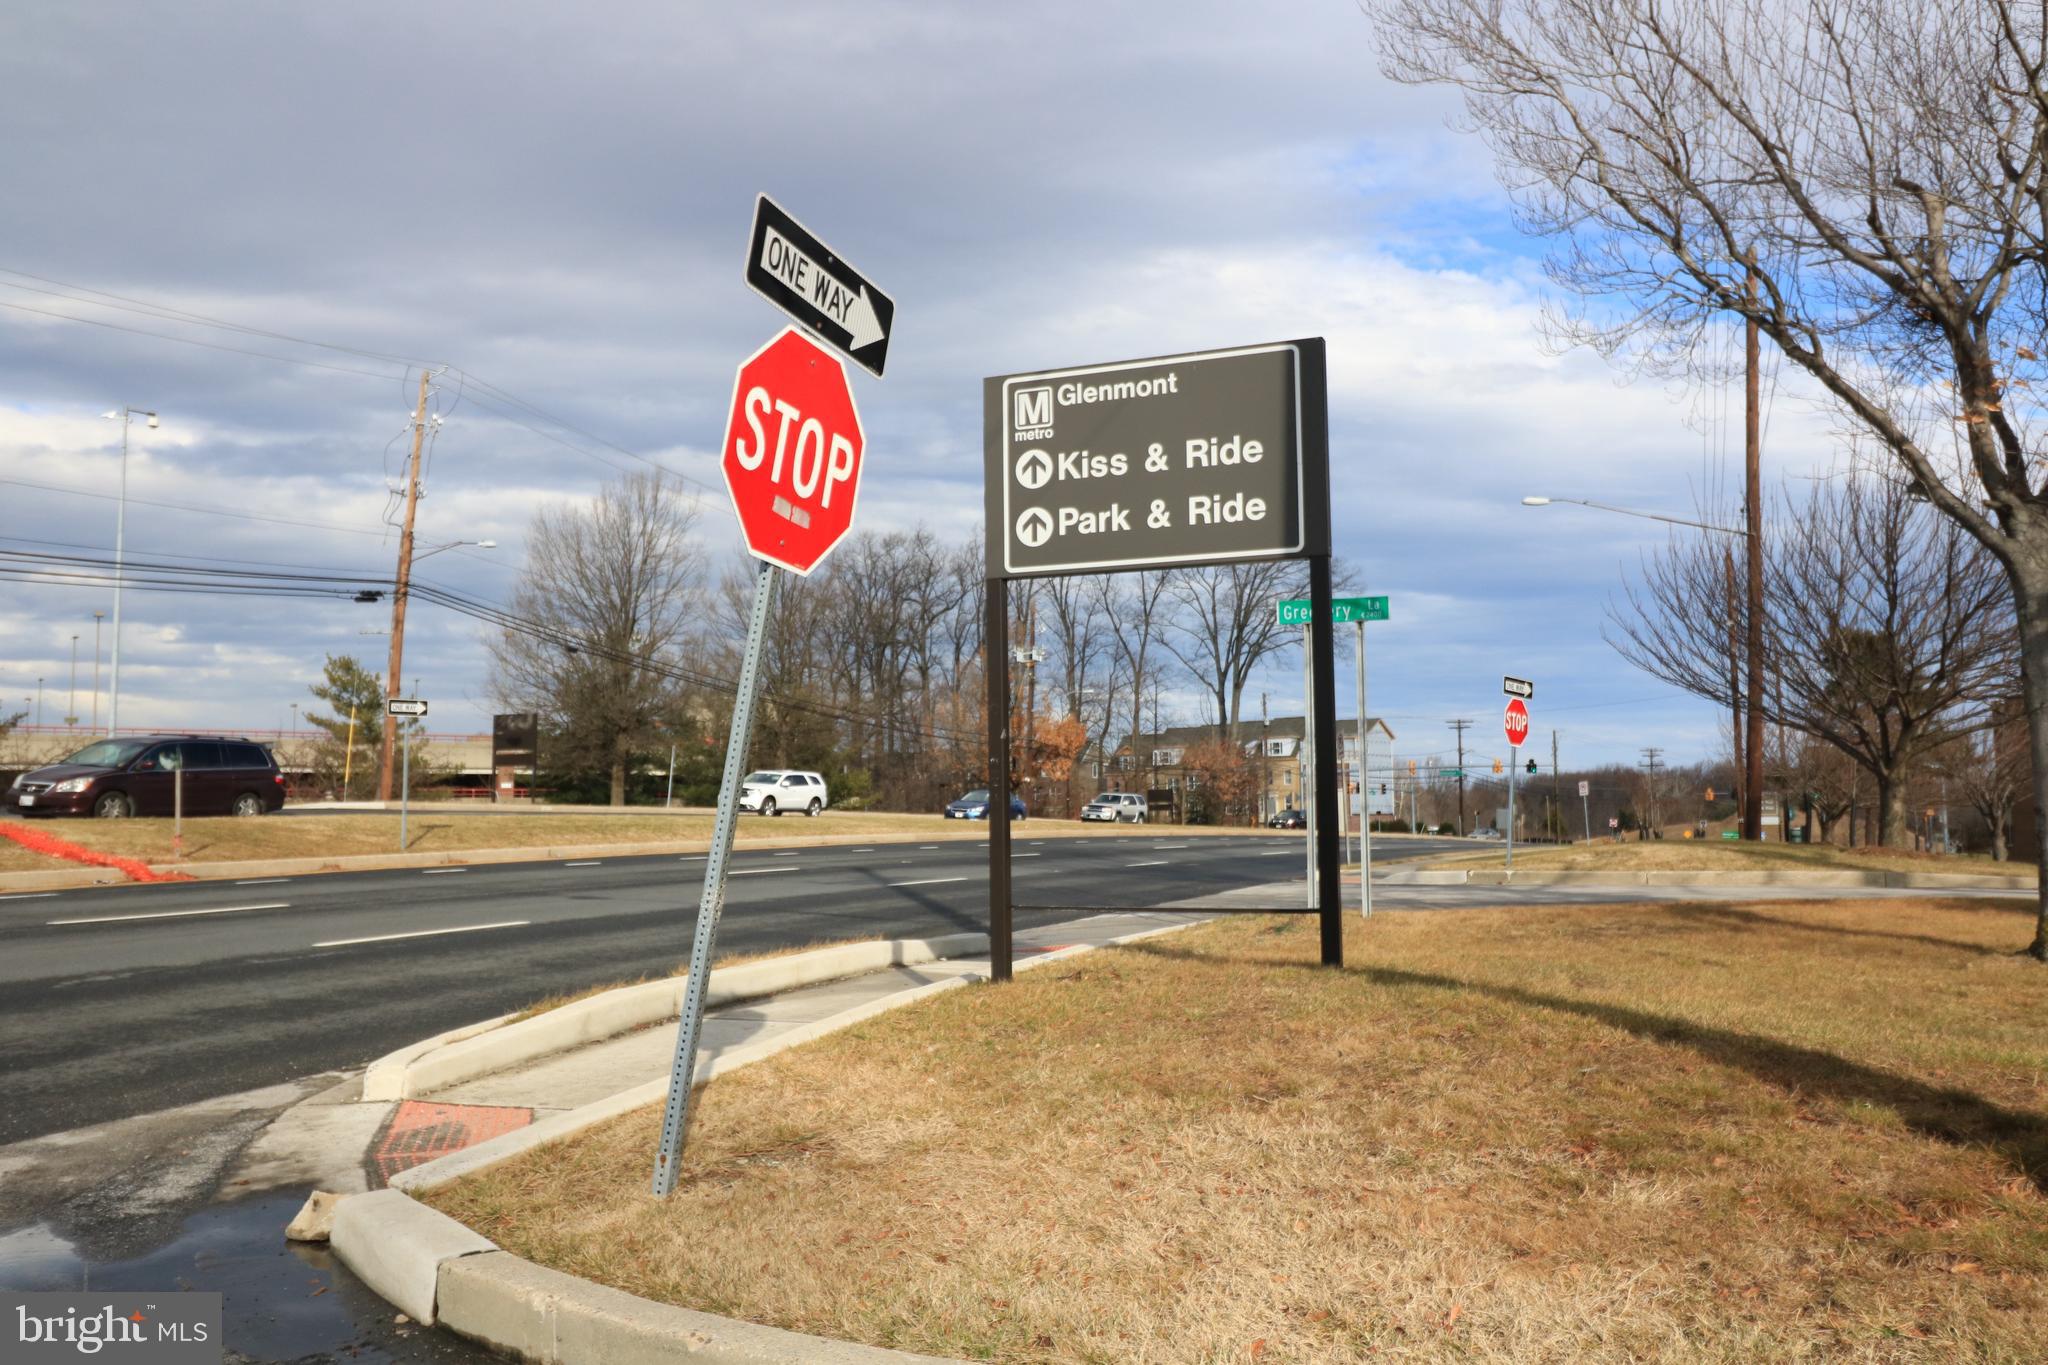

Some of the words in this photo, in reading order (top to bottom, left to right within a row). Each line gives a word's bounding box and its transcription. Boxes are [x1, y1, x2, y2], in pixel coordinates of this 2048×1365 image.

[767, 236, 807, 294] ONE
[812, 271, 855, 325] WAY
[1057, 372, 1178, 407] Glenmont
[1018, 390, 1050, 426] M
[735, 386, 855, 510] STOP
[1014, 427, 1054, 442] metro
[1057, 450, 1129, 481] Kiss
[1144, 442, 1169, 472] &
[1185, 435, 1264, 469] Ride
[1058, 503, 1132, 536] Park
[1146, 499, 1172, 529] &
[1188, 492, 1267, 525] Ride
[1283, 604, 1352, 621] Grery
[1505, 712, 1527, 732] STOP
